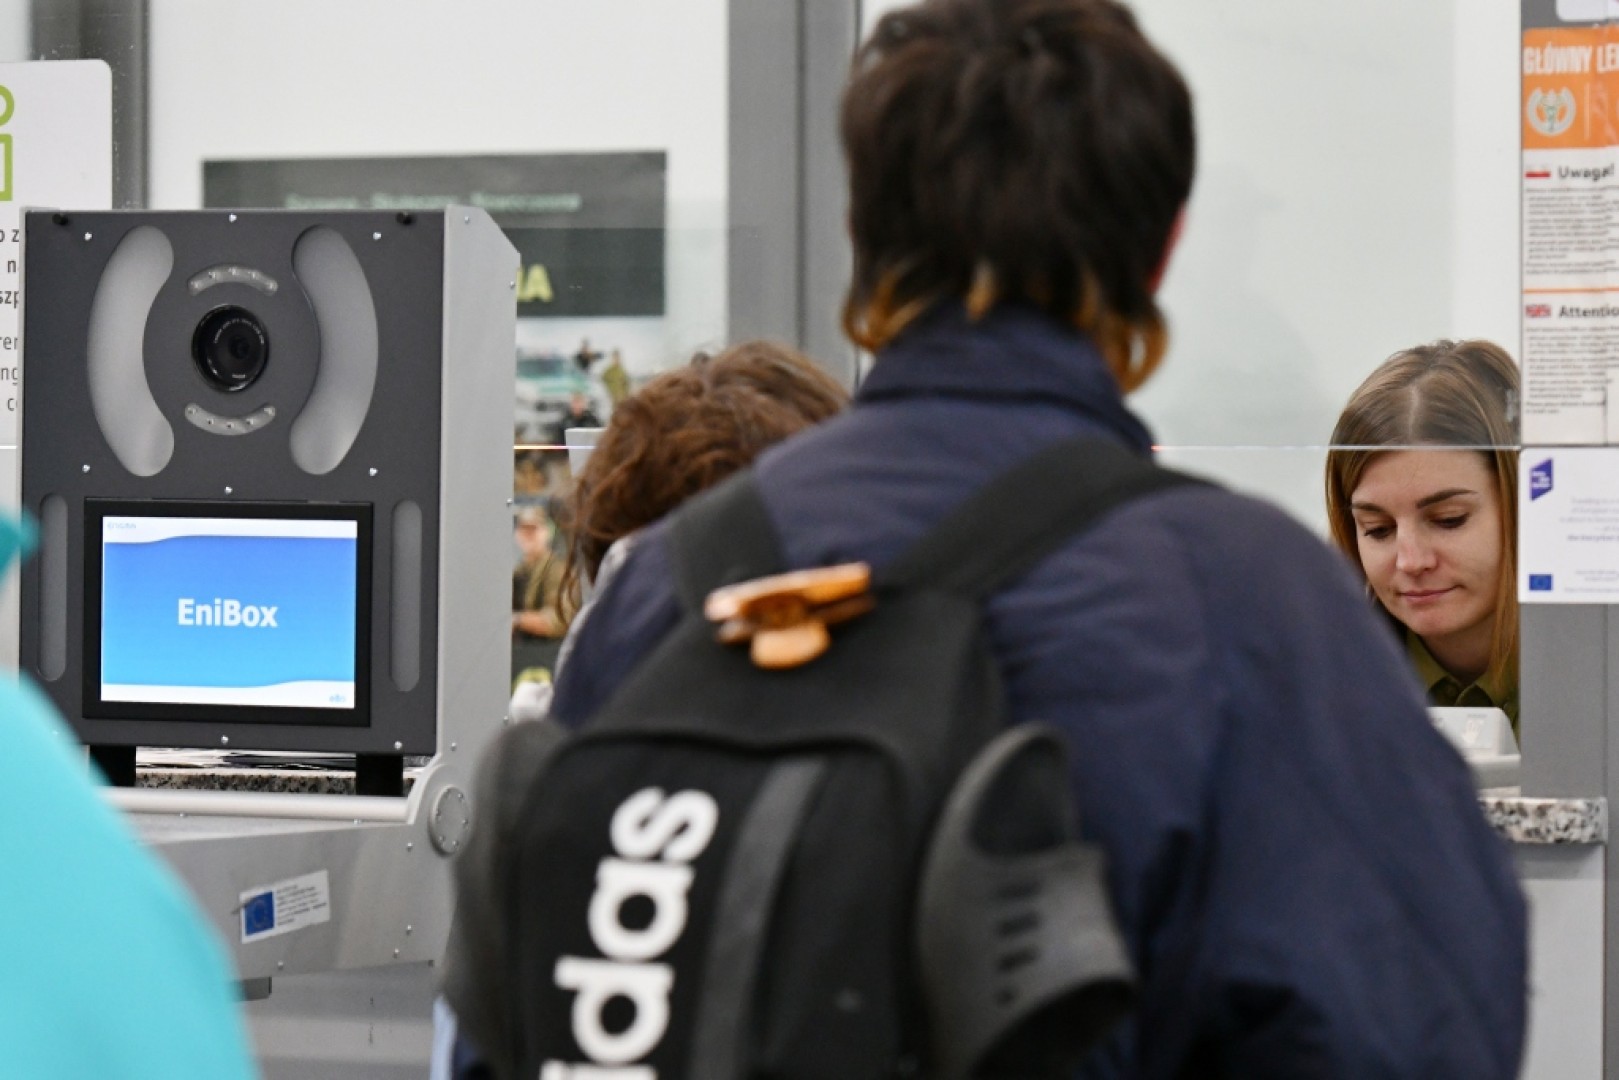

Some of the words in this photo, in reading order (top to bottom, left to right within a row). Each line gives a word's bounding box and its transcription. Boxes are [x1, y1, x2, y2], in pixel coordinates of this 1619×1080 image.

[1523, 41, 1592, 74] GŁÓWNY
[1557, 163, 1615, 182] Uwaga!
[177, 598, 279, 628] EniBox
